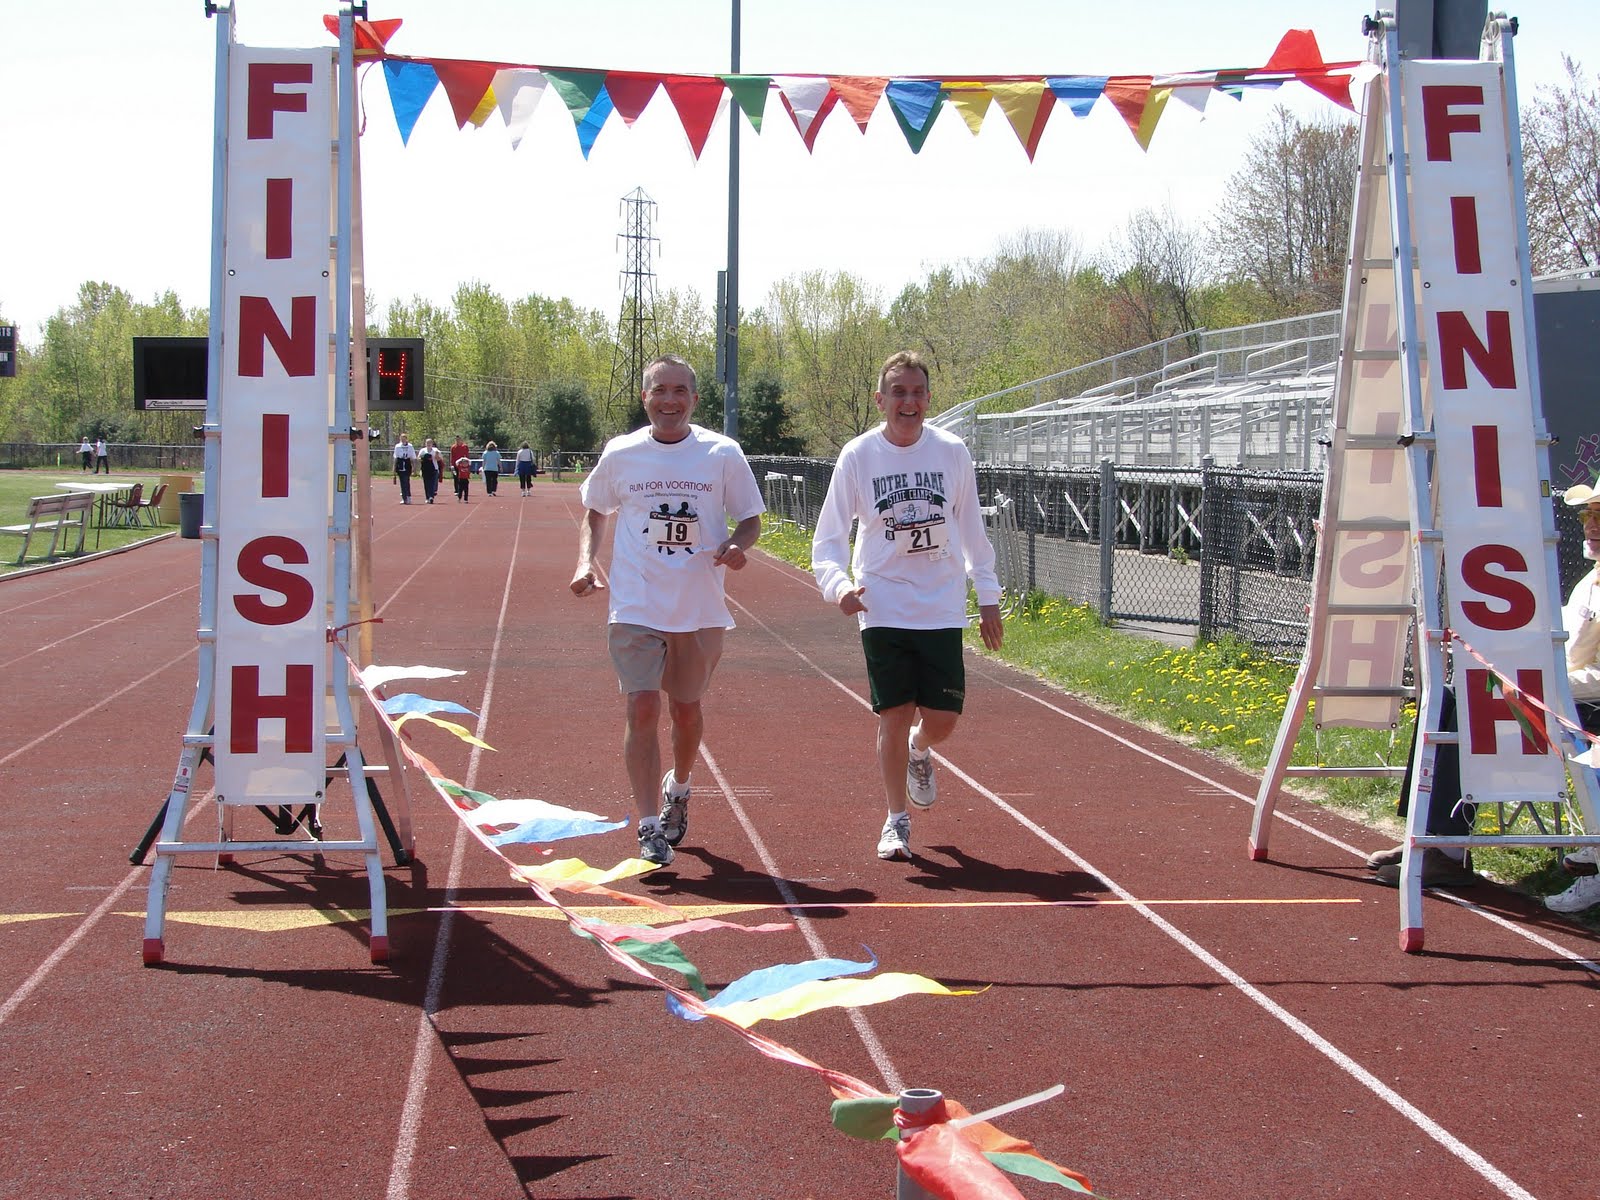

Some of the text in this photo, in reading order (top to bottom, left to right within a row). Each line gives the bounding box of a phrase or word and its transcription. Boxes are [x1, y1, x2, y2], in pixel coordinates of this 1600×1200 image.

[378, 352, 406, 396] 4
[231, 65, 314, 754] FINISH
[1422, 86, 1547, 755] FINISH
[629, 480, 713, 493] RUN FOR VOCATIONS
[872, 472, 945, 501] NOTRE DAME
[888, 489, 933, 505] STATE CHAMPS
[664, 521, 688, 542] 19
[910, 528, 932, 549] 21
